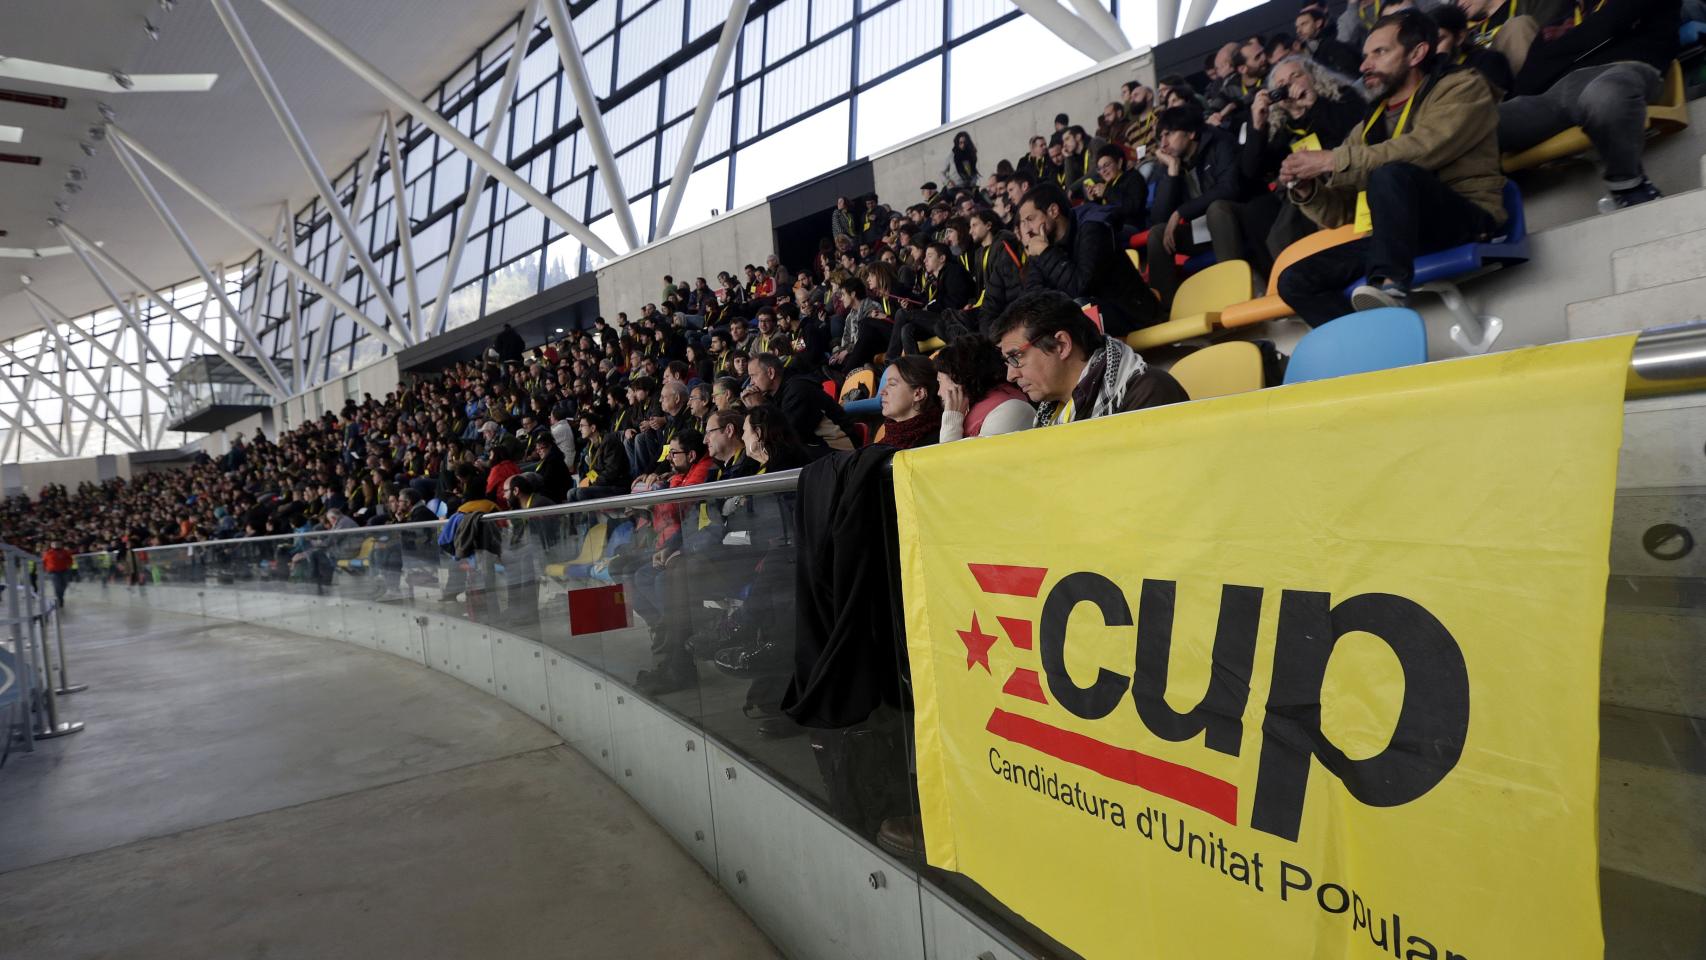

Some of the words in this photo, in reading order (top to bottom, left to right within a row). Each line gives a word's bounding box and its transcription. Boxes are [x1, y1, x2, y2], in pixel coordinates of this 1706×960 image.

[1040, 572, 1470, 842] cup
[989, 747, 1126, 829] Candidatura
[1136, 806, 1264, 892] d'Unitat
[1280, 860, 1468, 960] Popula
